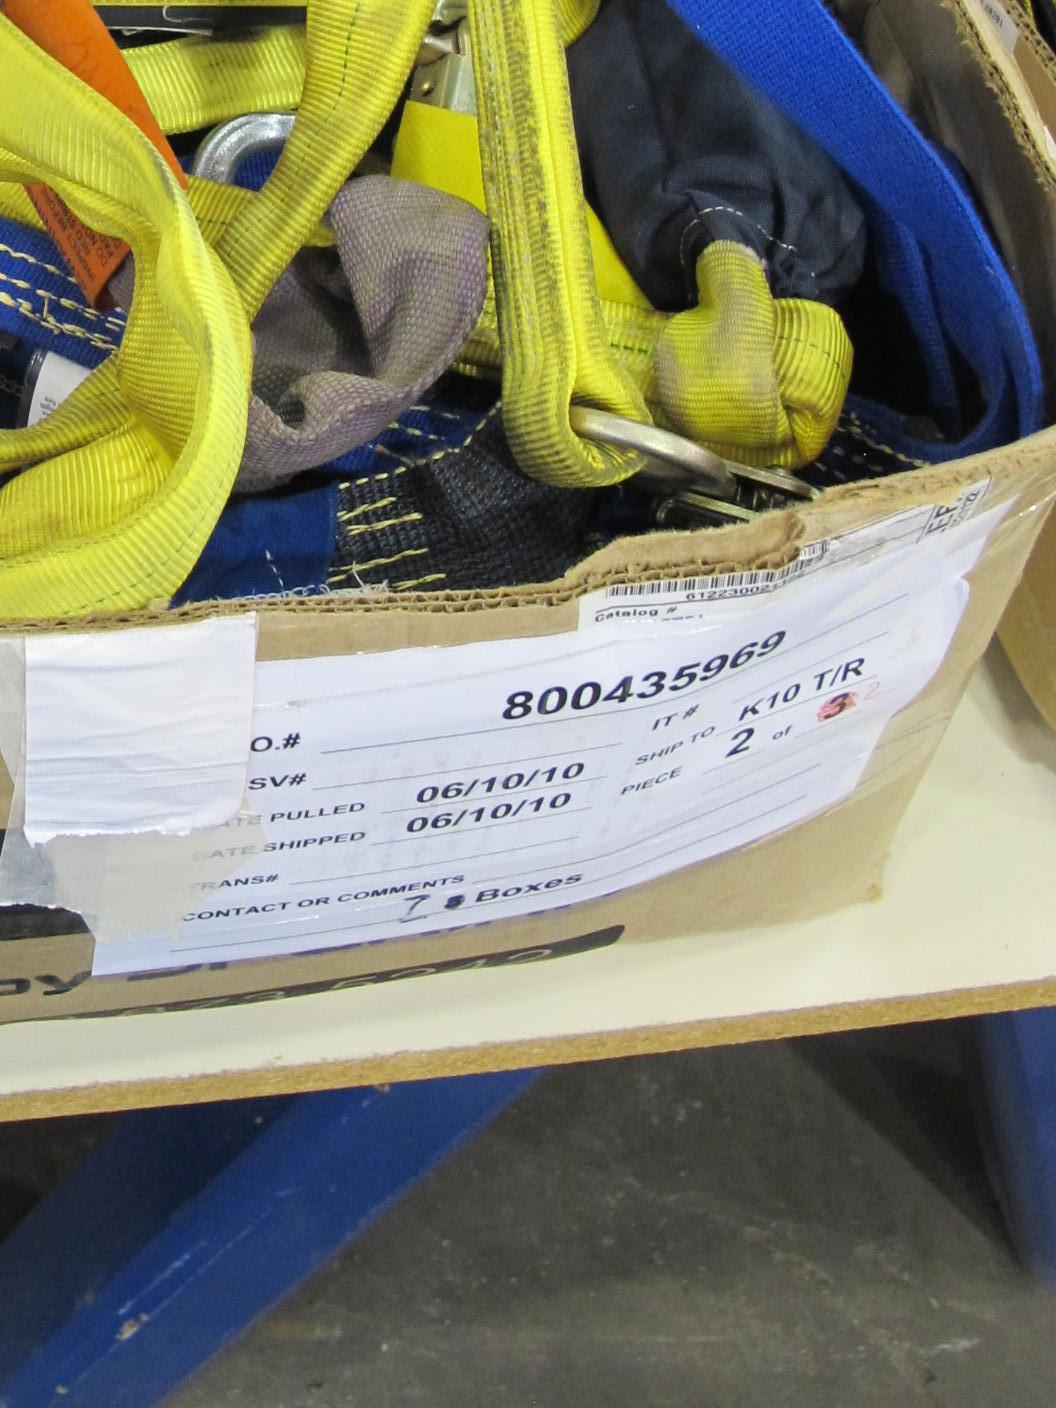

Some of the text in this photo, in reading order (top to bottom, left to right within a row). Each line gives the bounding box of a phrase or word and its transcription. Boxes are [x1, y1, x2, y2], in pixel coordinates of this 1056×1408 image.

[595, 608, 658, 623] Catalog
[502, 630, 786, 720] 800435969
[635, 657, 866, 766] SHIP TO K10 T/R
[620, 765, 683, 796] PIECE
[725, 727, 756, 758] 2
[772, 724, 793, 741] of
[270, 802, 366, 823] PULLED
[416, 762, 585, 804] 06/10/10
[262, 831, 366, 853] SHIPPED
[406, 793, 572, 833] 06/10/10
[183, 901, 292, 922] CONTACT
[298, 896, 330, 909] OR
[337, 874, 465, 903] COMMENTS
[475, 873, 584, 903] Boxes
